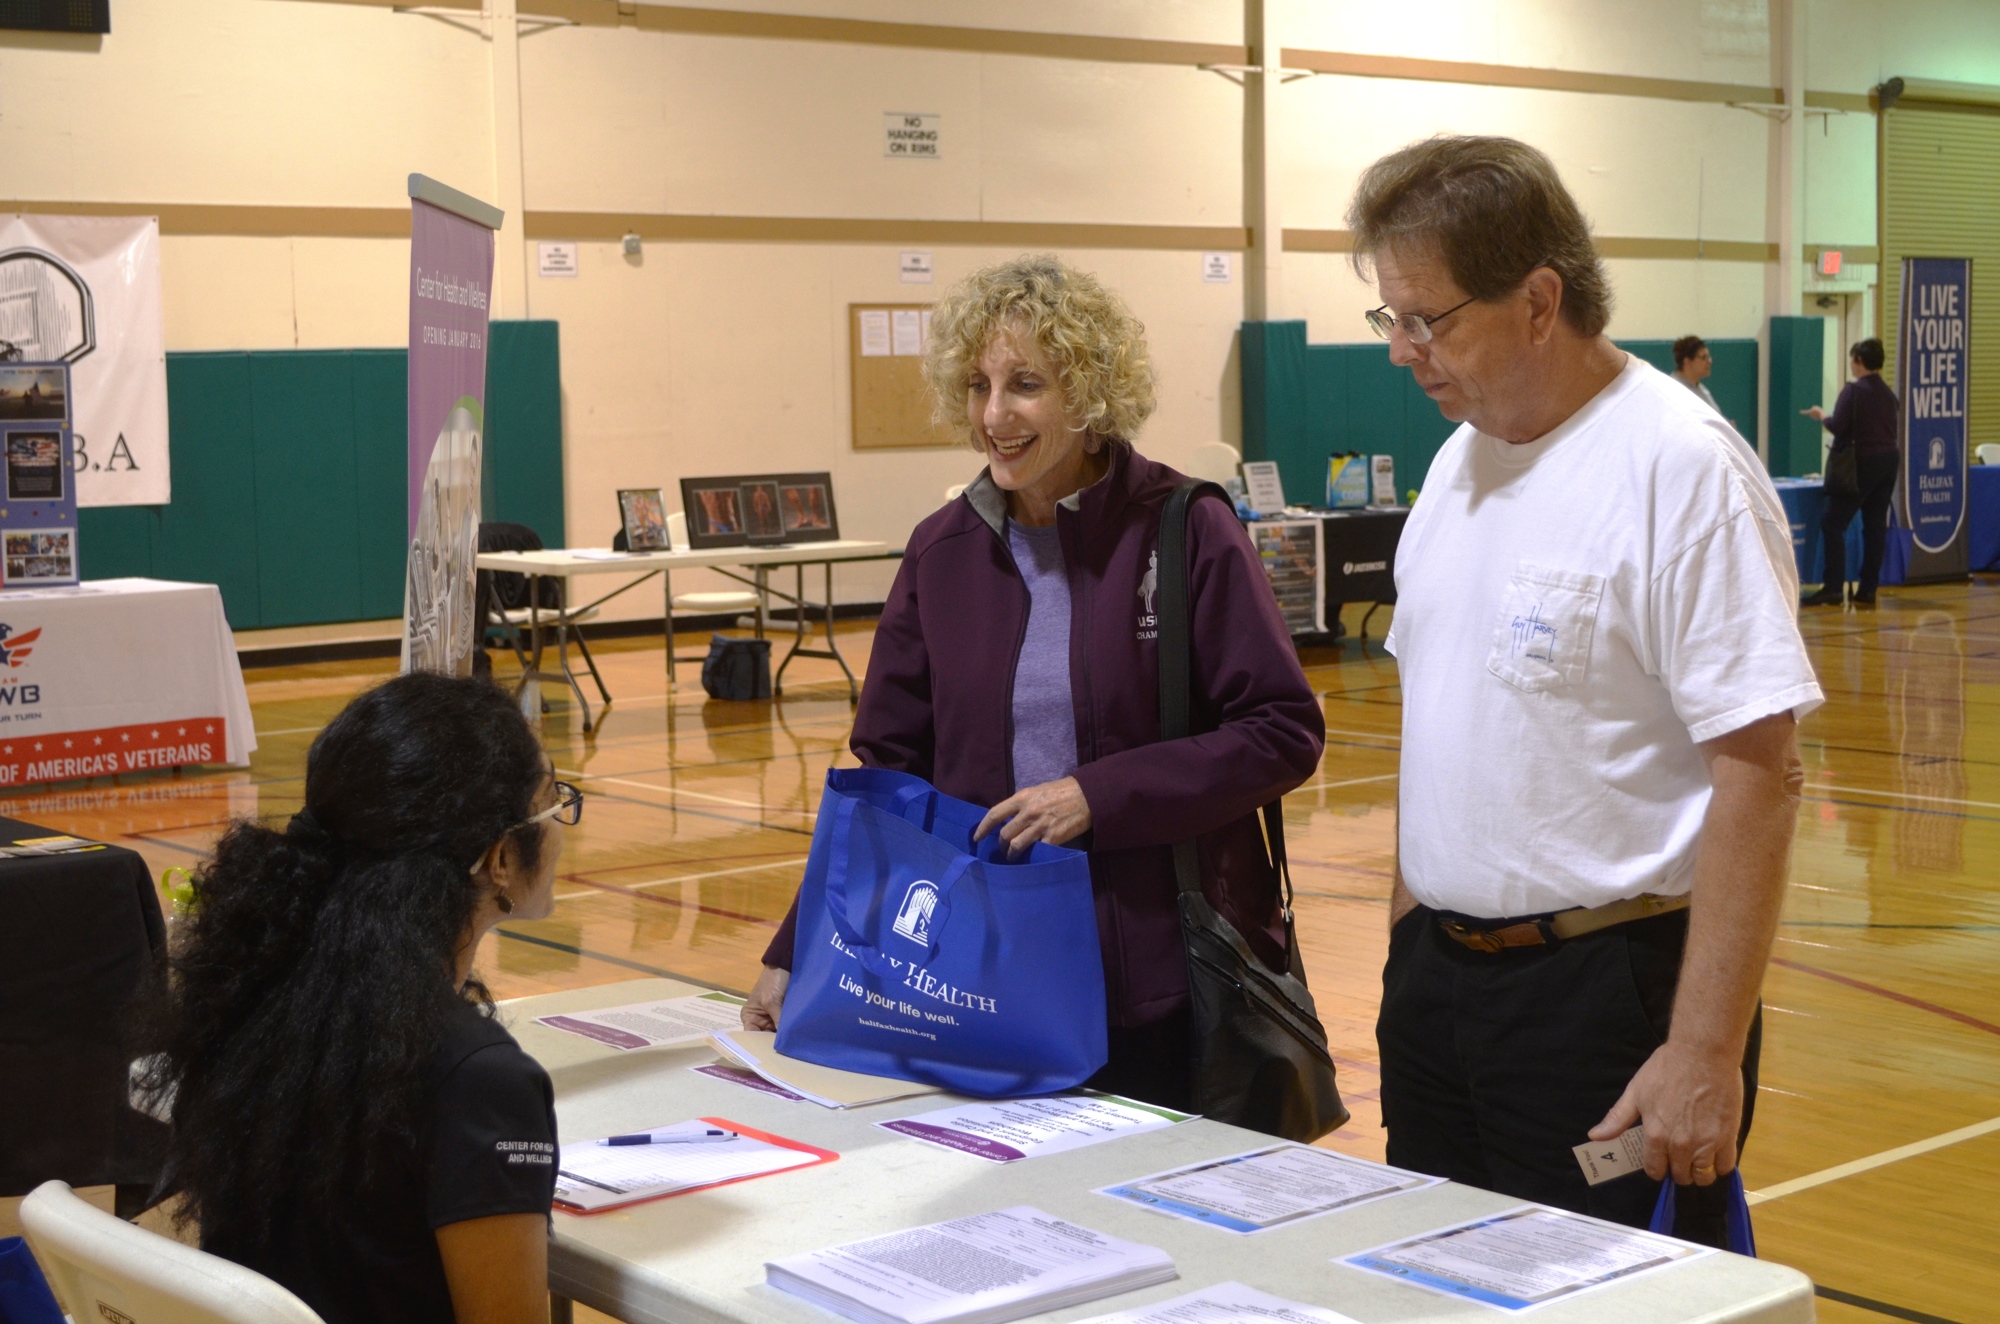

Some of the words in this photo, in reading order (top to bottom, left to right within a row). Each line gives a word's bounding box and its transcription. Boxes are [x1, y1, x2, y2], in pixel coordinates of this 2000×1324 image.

[904, 117, 922, 128] NO
[887, 130, 938, 141] HANGING
[890, 142, 907, 153] ON
[911, 143, 936, 154] RIMS
[416, 266, 434, 299] Center
[435, 270, 443, 300] for
[444, 274, 458, 303] Health
[460, 278, 468, 306] and
[468, 281, 486, 310] Wellness
[1920, 284, 1958, 316] LIVE
[424, 325, 447, 346] OPENING
[448, 329, 468, 348] JANUARY
[470, 332, 481, 349] 2016
[1914, 319, 1963, 350] YOUR
[1920, 353, 1957, 384] LIFE
[1913, 386, 1962, 419] WELL
[1920, 475, 1953, 490] HALIFAX
[1922, 491, 1951, 504] HEALTH
[14, 712, 42, 720] TURN
[0, 764, 19, 784] OF
[26, 752, 119, 781] AMERICA'S
[124, 742, 212, 769] VETERANS
[838, 974, 864, 997] Live
[866, 990, 896, 1011] your
[900, 1001, 920, 1018] life
[924, 1011, 960, 1026] well.
[903, 962, 998, 1014] HEALTH
[858, 1016, 937, 1041] halifaxhealth.org
[496, 1141, 528, 1151] CENTER
[530, 1142, 543, 1151] FOR
[508, 1153, 524, 1163] AND
[1589, 1162, 1600, 1178] Thank
